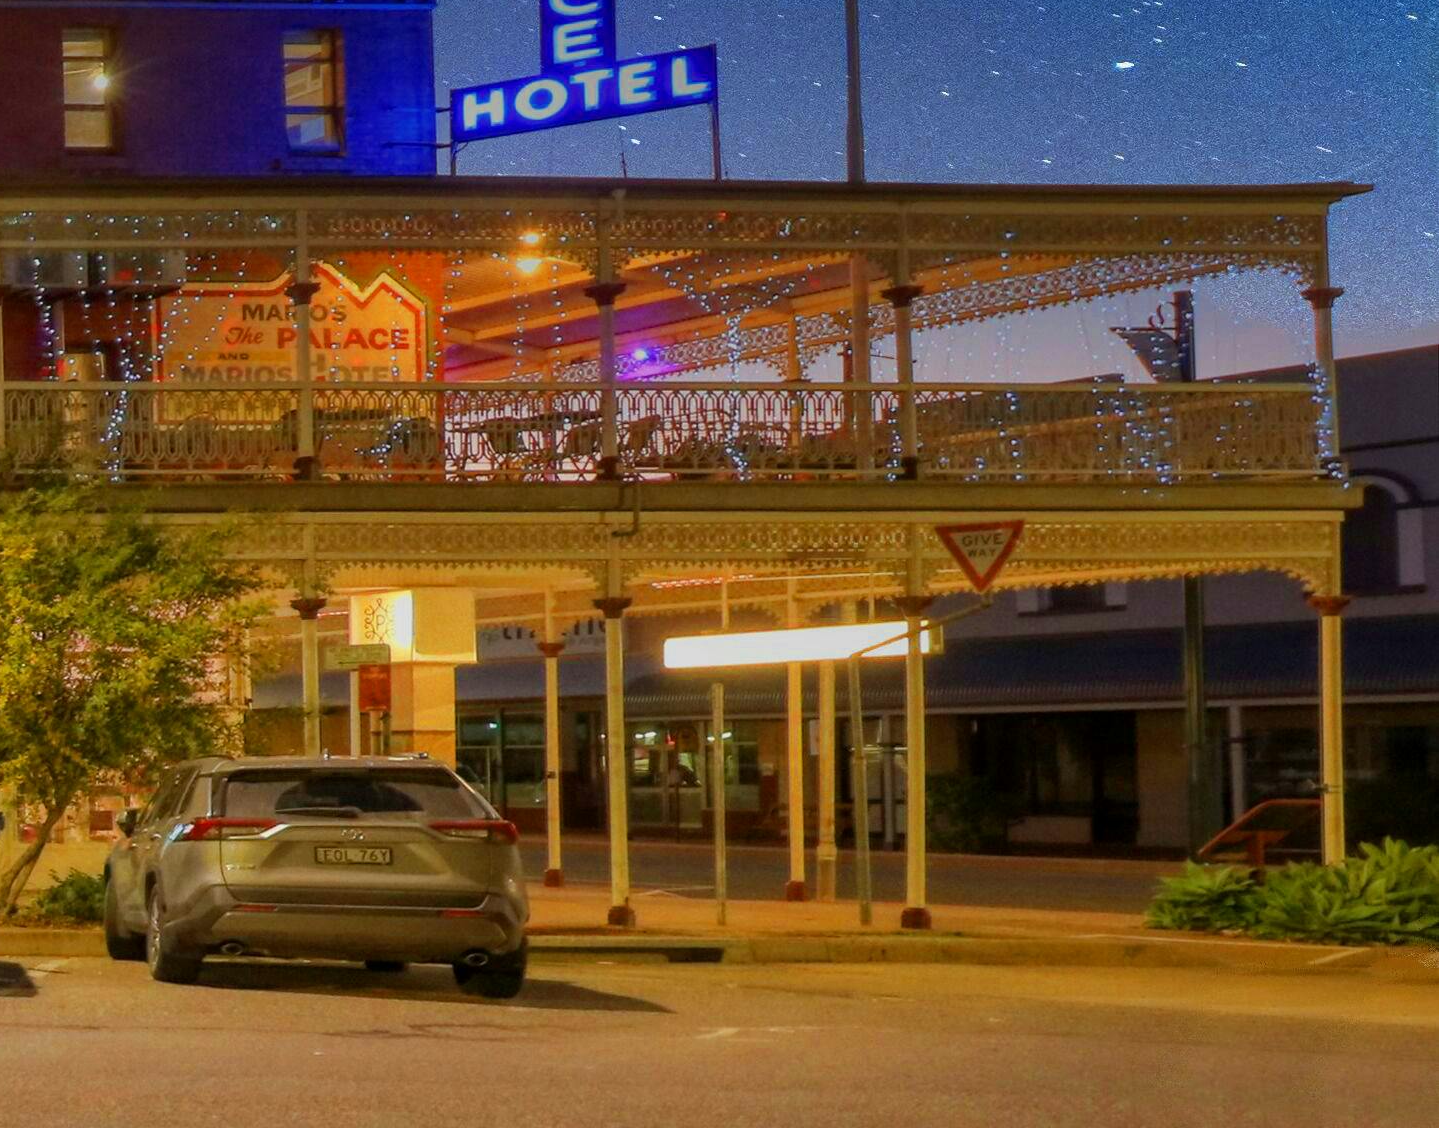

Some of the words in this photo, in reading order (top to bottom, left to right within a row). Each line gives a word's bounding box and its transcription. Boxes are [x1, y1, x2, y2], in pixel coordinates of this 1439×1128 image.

[462, 56, 711, 131] HOTEL
[242, 303, 347, 322] MARO'S
[224, 327, 264, 344] The
[218, 353, 249, 361] AND
[963, 532, 1004, 546] GIVE
[968, 548, 996, 557] WAY
